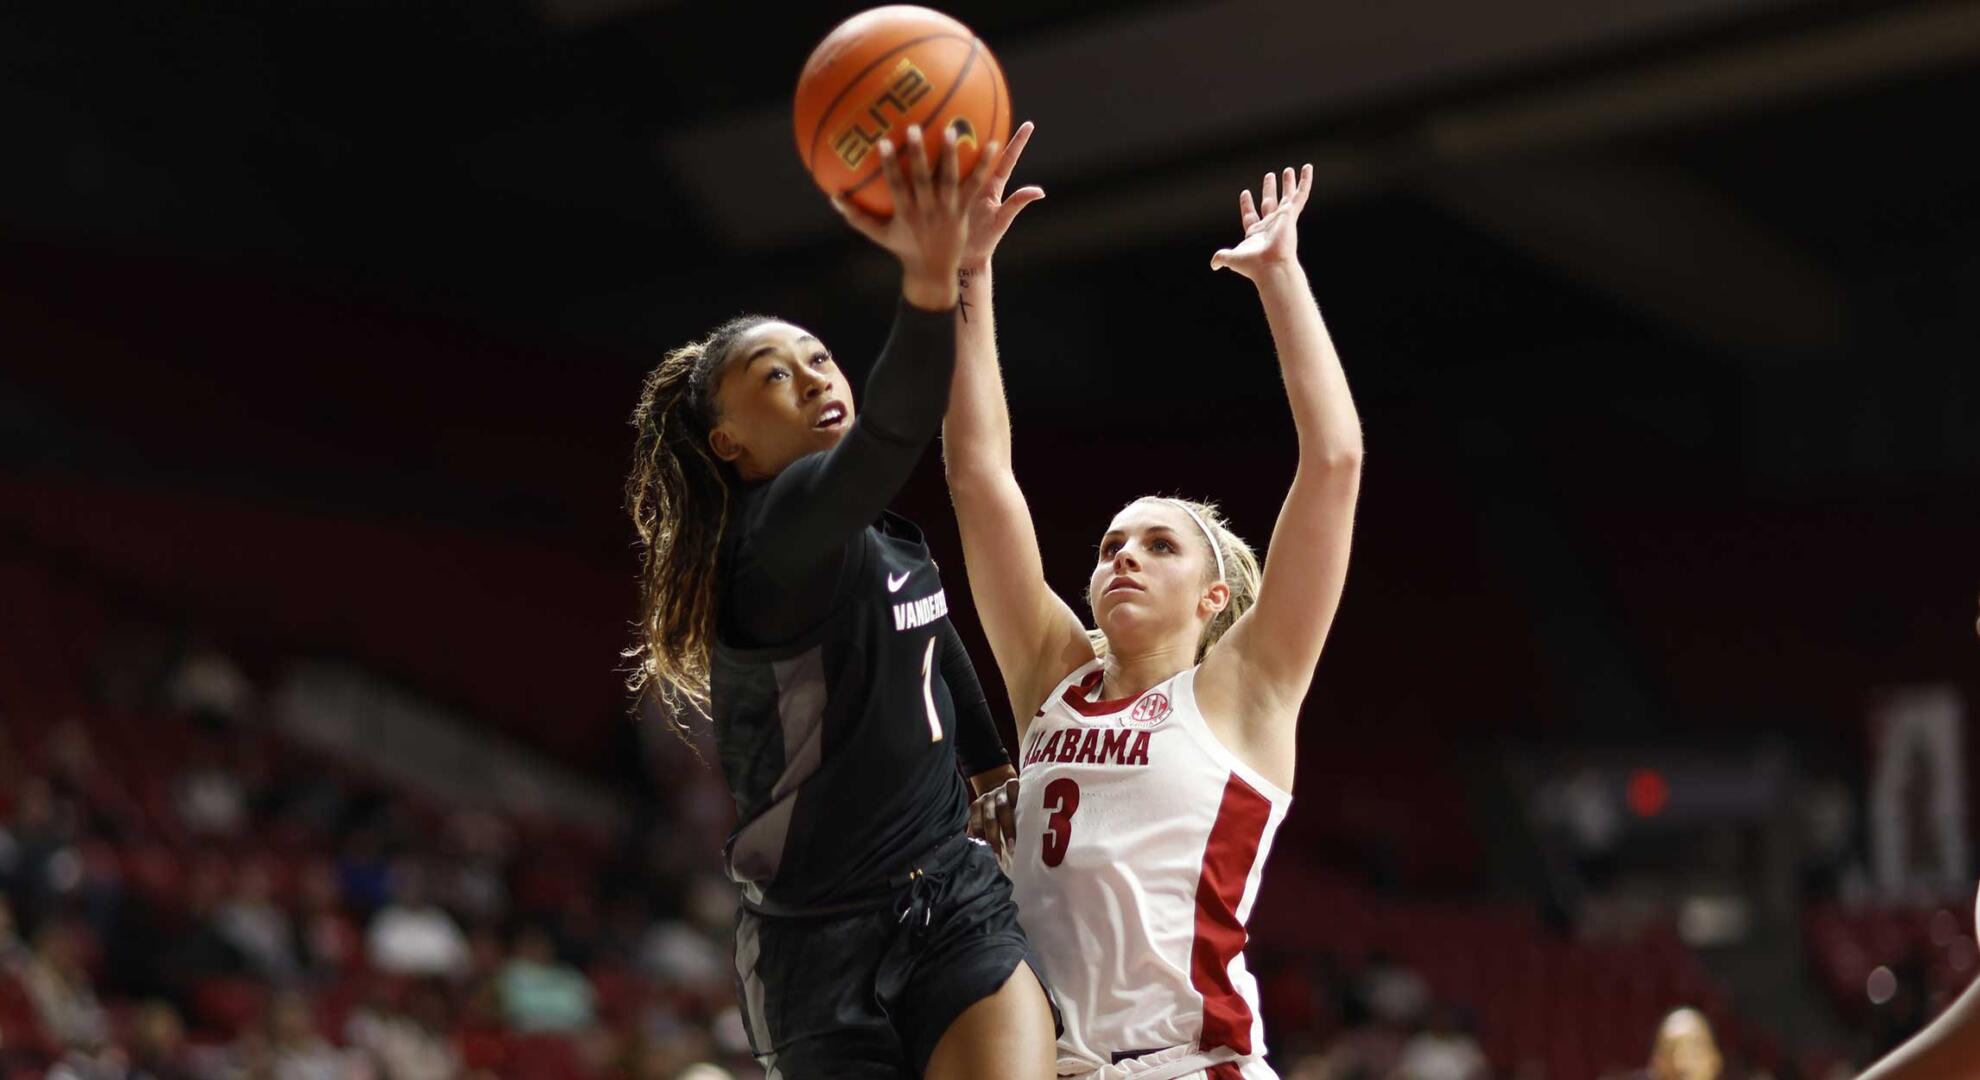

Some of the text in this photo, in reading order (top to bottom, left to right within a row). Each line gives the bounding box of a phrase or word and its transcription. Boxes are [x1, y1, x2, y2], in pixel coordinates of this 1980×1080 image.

[832, 64, 933, 169] ELITE
[921, 636, 944, 743] 1
[1133, 693, 1168, 721] SEC
[1042, 778, 1080, 867] 3
